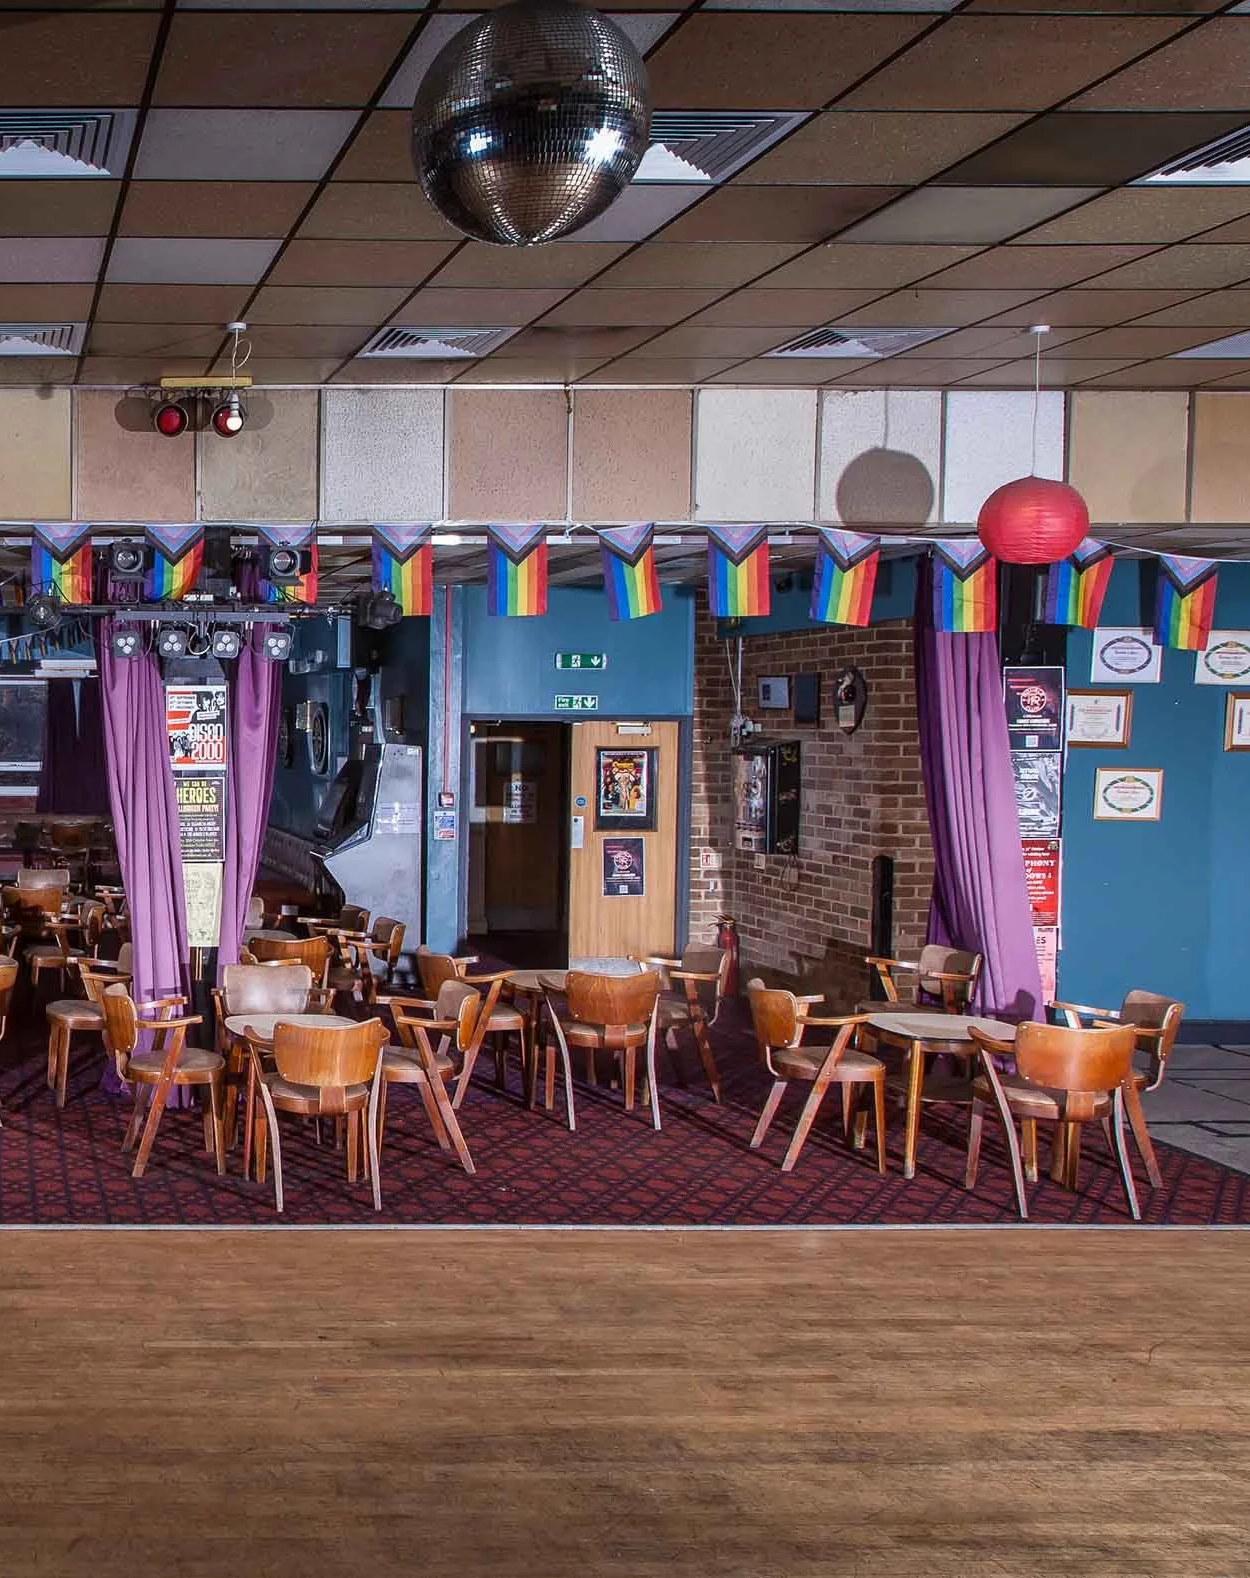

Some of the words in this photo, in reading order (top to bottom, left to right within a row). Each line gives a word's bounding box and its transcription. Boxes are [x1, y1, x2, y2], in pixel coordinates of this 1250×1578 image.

[189, 723, 223, 742] DISCO
[191, 742, 223, 760] 2000
[176, 787, 216, 804] HEROES
